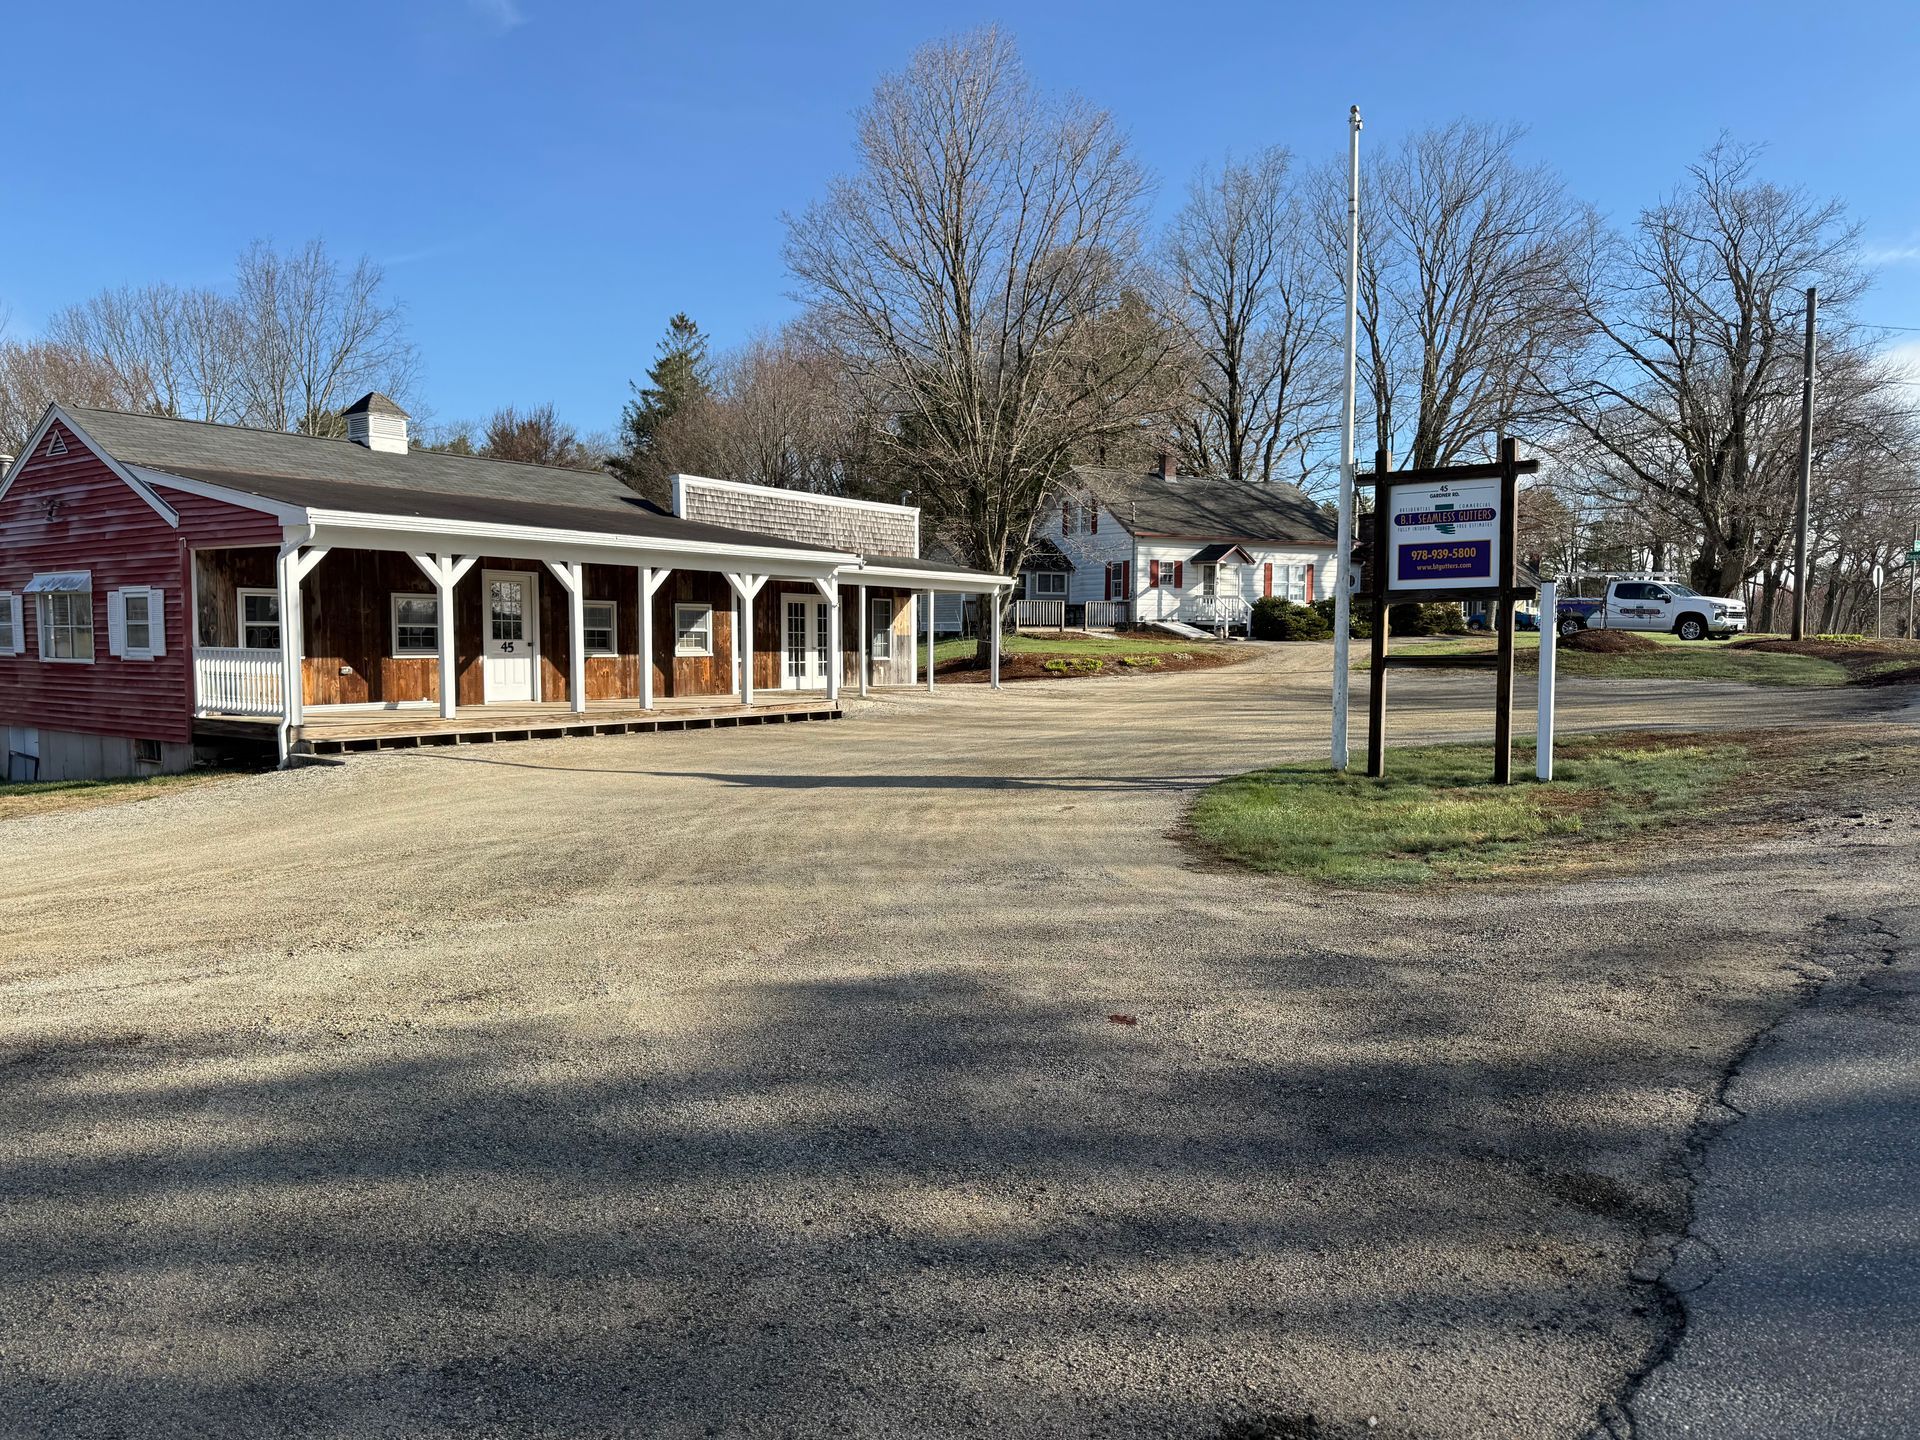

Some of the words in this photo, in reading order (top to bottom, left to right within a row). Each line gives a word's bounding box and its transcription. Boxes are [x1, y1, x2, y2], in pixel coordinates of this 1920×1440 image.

[1401, 515, 1415, 524] B.T.
[1418, 511, 1455, 524] SEAMLESS
[1459, 509, 1492, 521] GUTTERS
[1411, 547, 1476, 561] 978-939-5800
[1416, 562, 1472, 571] www.btgutters.com
[501, 641, 514, 653] 45
